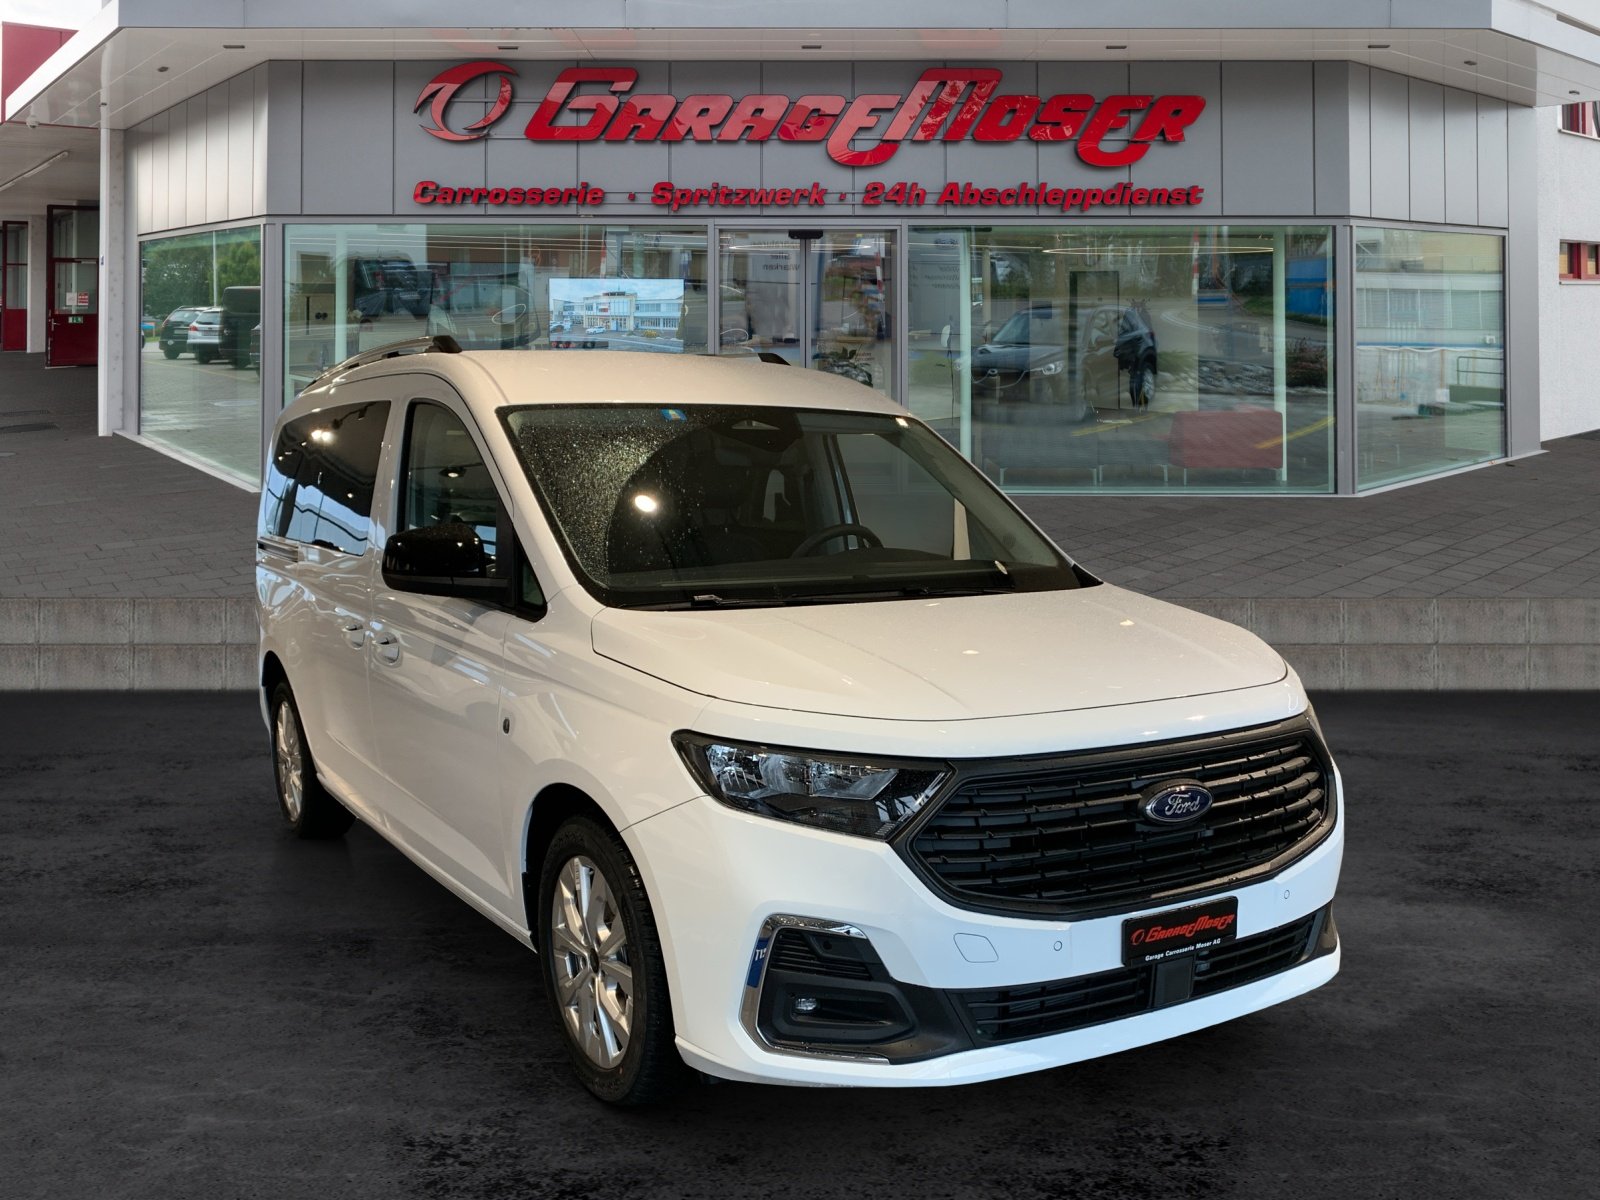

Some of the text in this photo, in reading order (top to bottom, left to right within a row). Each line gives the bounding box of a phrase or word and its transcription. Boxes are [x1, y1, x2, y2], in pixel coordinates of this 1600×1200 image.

[413, 180, 605, 206] Carrosserie
[651, 180, 827, 212] Spritzwerk
[862, 182, 927, 206] 24h
[936, 181, 1205, 212] Abschleppdienst
[1164, 792, 1200, 815] Ford
[1145, 938, 1221, 961] Garage Carrosserie Moser AG
